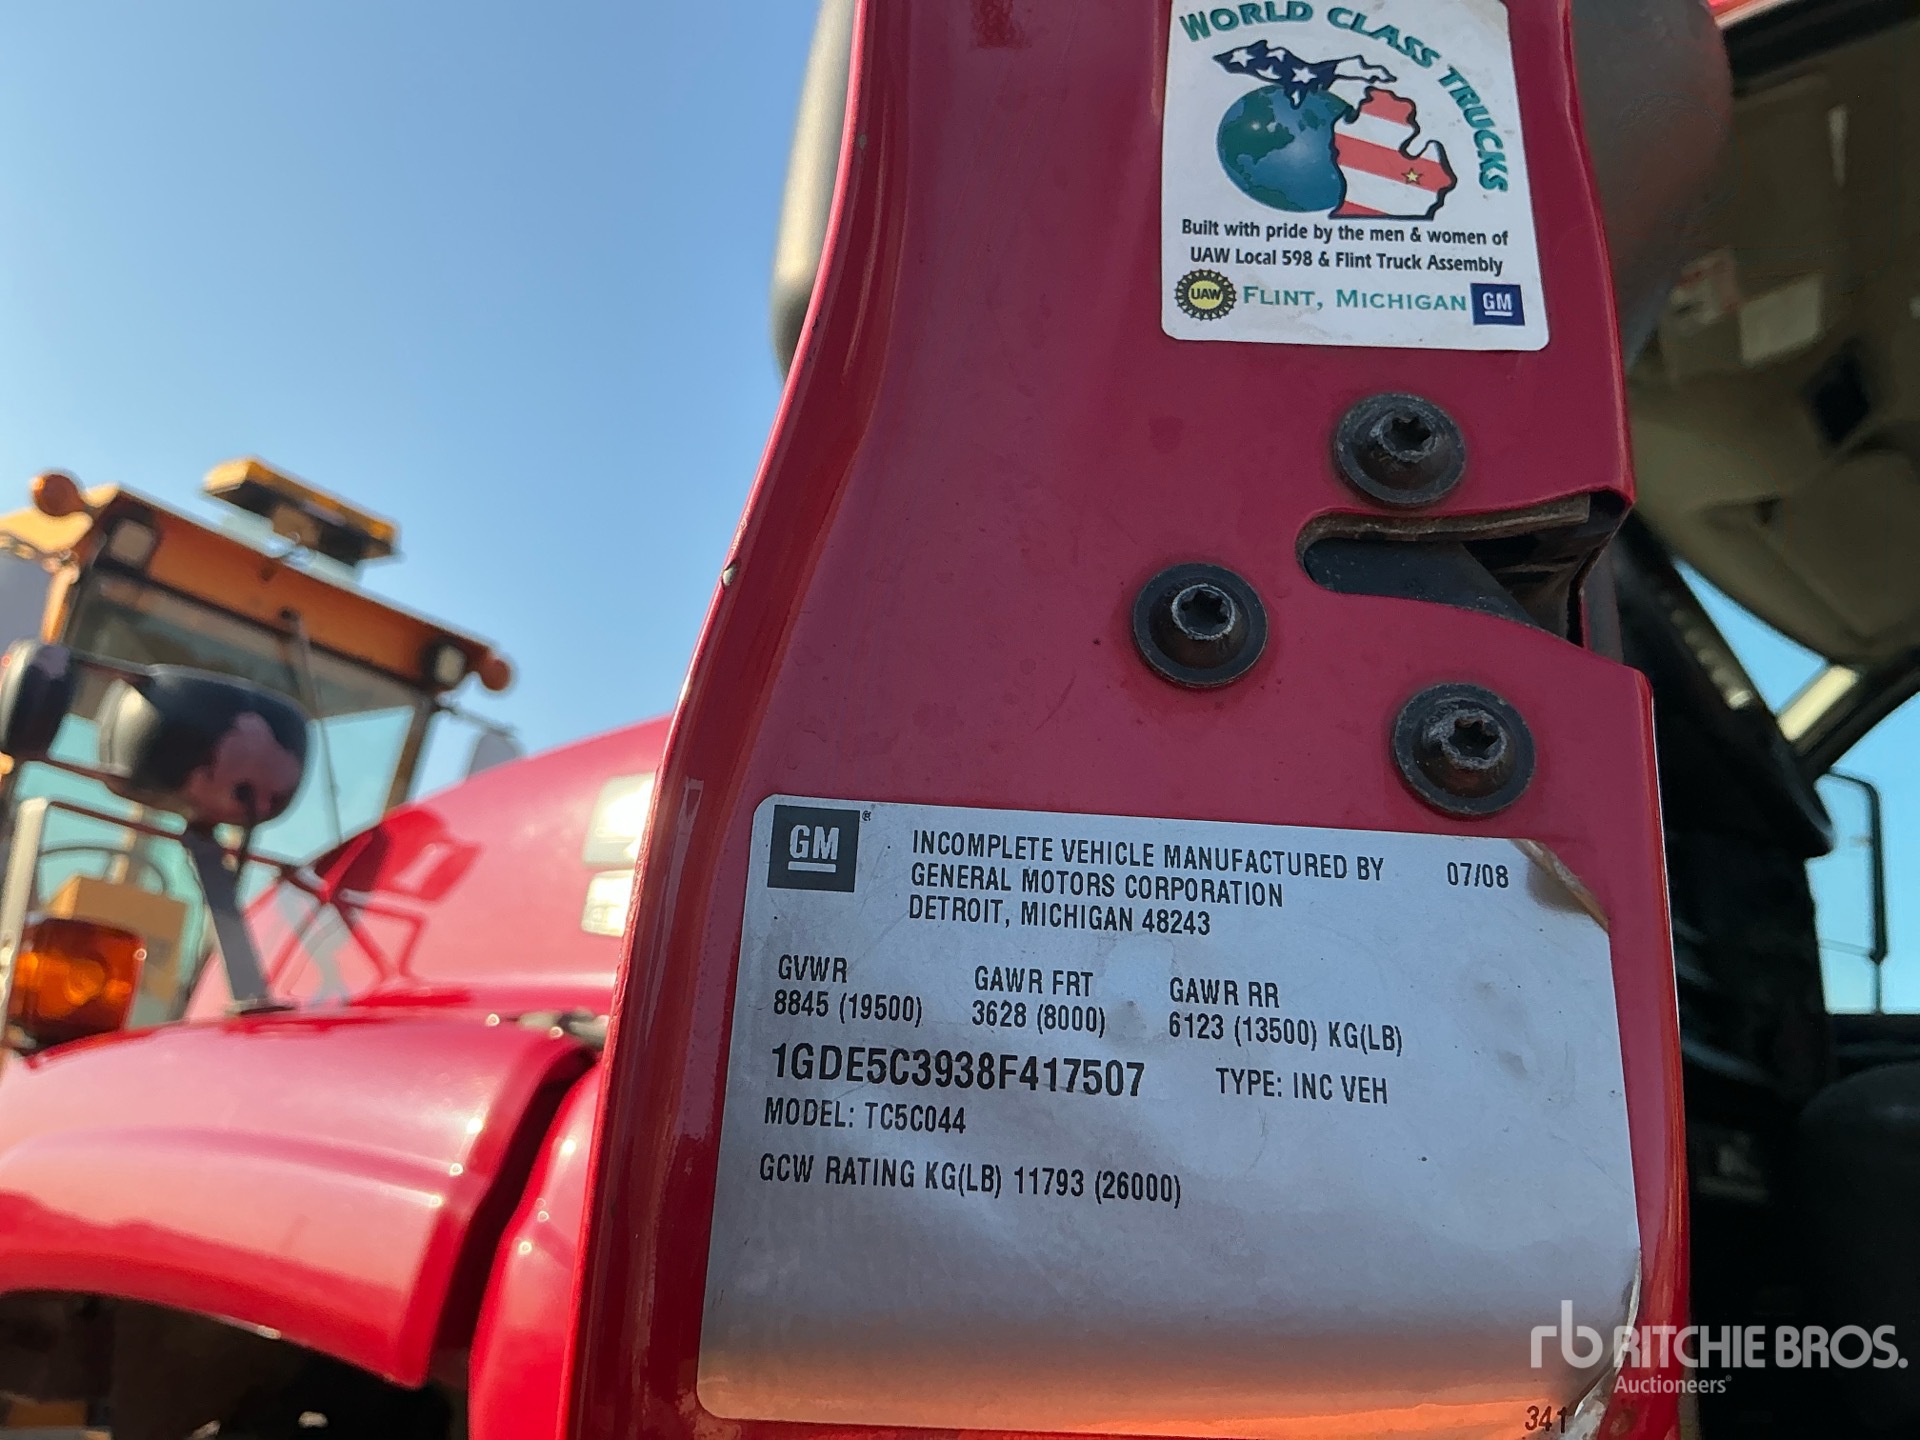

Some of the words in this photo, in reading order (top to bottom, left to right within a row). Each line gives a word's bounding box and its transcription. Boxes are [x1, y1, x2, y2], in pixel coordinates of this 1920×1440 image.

[1179, 1, 1314, 42] WORLD
[1327, 7, 1441, 69] CLASS
[1438, 65, 1509, 192] TRUCKS
[1182, 219, 1219, 236] Built
[1224, 222, 1260, 237] with
[1266, 224, 1308, 241] pride
[1313, 223, 1333, 243] by
[1338, 224, 1364, 241] the
[1369, 229, 1404, 242] men
[1410, 228, 1421, 243] &
[1427, 230, 1486, 245] women
[1492, 231, 1508, 245] of
[1190, 247, 1230, 263] UAW
[1235, 249, 1276, 265] Local
[1282, 250, 1313, 266] 598
[1318, 251, 1330, 267] &
[1336, 252, 1372, 268] Flint
[1376, 253, 1422, 270] Truck
[1427, 256, 1503, 276] Assembly
[1190, 287, 1221, 300] UAW
[1482, 292, 1513, 311] GM
[788, 825, 840, 861] GM
[911, 830, 1053, 862] INCOMPLETE
[1061, 839, 1155, 868] VEHICLE
[1164, 845, 1348, 879] MANUFACTURED
[1357, 857, 1385, 881] BY
[911, 862, 1011, 892] GENERAL
[1022, 868, 1115, 898] MOTORS
[1125, 875, 1283, 907] CORPORATION
[1446, 862, 1509, 888] 07/08
[909, 895, 1011, 928] DETROIT,
[1020, 902, 1133, 932] MICHIGAN
[1142, 909, 1211, 935] 48243
[777, 954, 848, 984] GVWR
[974, 966, 1043, 995] GAWR
[1052, 971, 1094, 997] FRT
[774, 990, 829, 1017] 8845
[839, 994, 923, 1026] (19500)
[1170, 977, 1239, 1006] GAWR
[1248, 982, 1280, 1008] RR
[972, 1001, 1027, 1028] 3628
[1036, 1004, 1106, 1037] (8000)
[1169, 1012, 1224, 1040] 6123
[1234, 1016, 1316, 1051] (13500)
[1329, 1021, 1402, 1057] KG(LB)
[772, 1042, 1145, 1097] 1GDE5C3938F417507
[1216, 1068, 1282, 1098] TYPE:
[1292, 1072, 1333, 1100] INC
[1341, 1075, 1389, 1104] VEH
[764, 1097, 854, 1128] MODEL:
[865, 1102, 966, 1134] TC5C044
[759, 1153, 815, 1184] GCW
[825, 1156, 915, 1188] RATING
[925, 1161, 1001, 1197] KG(LB)
[1013, 1167, 1084, 1197] 11793
[1094, 1171, 1181, 1208] (26000)
[1524, 1405, 1568, 1434] 341
